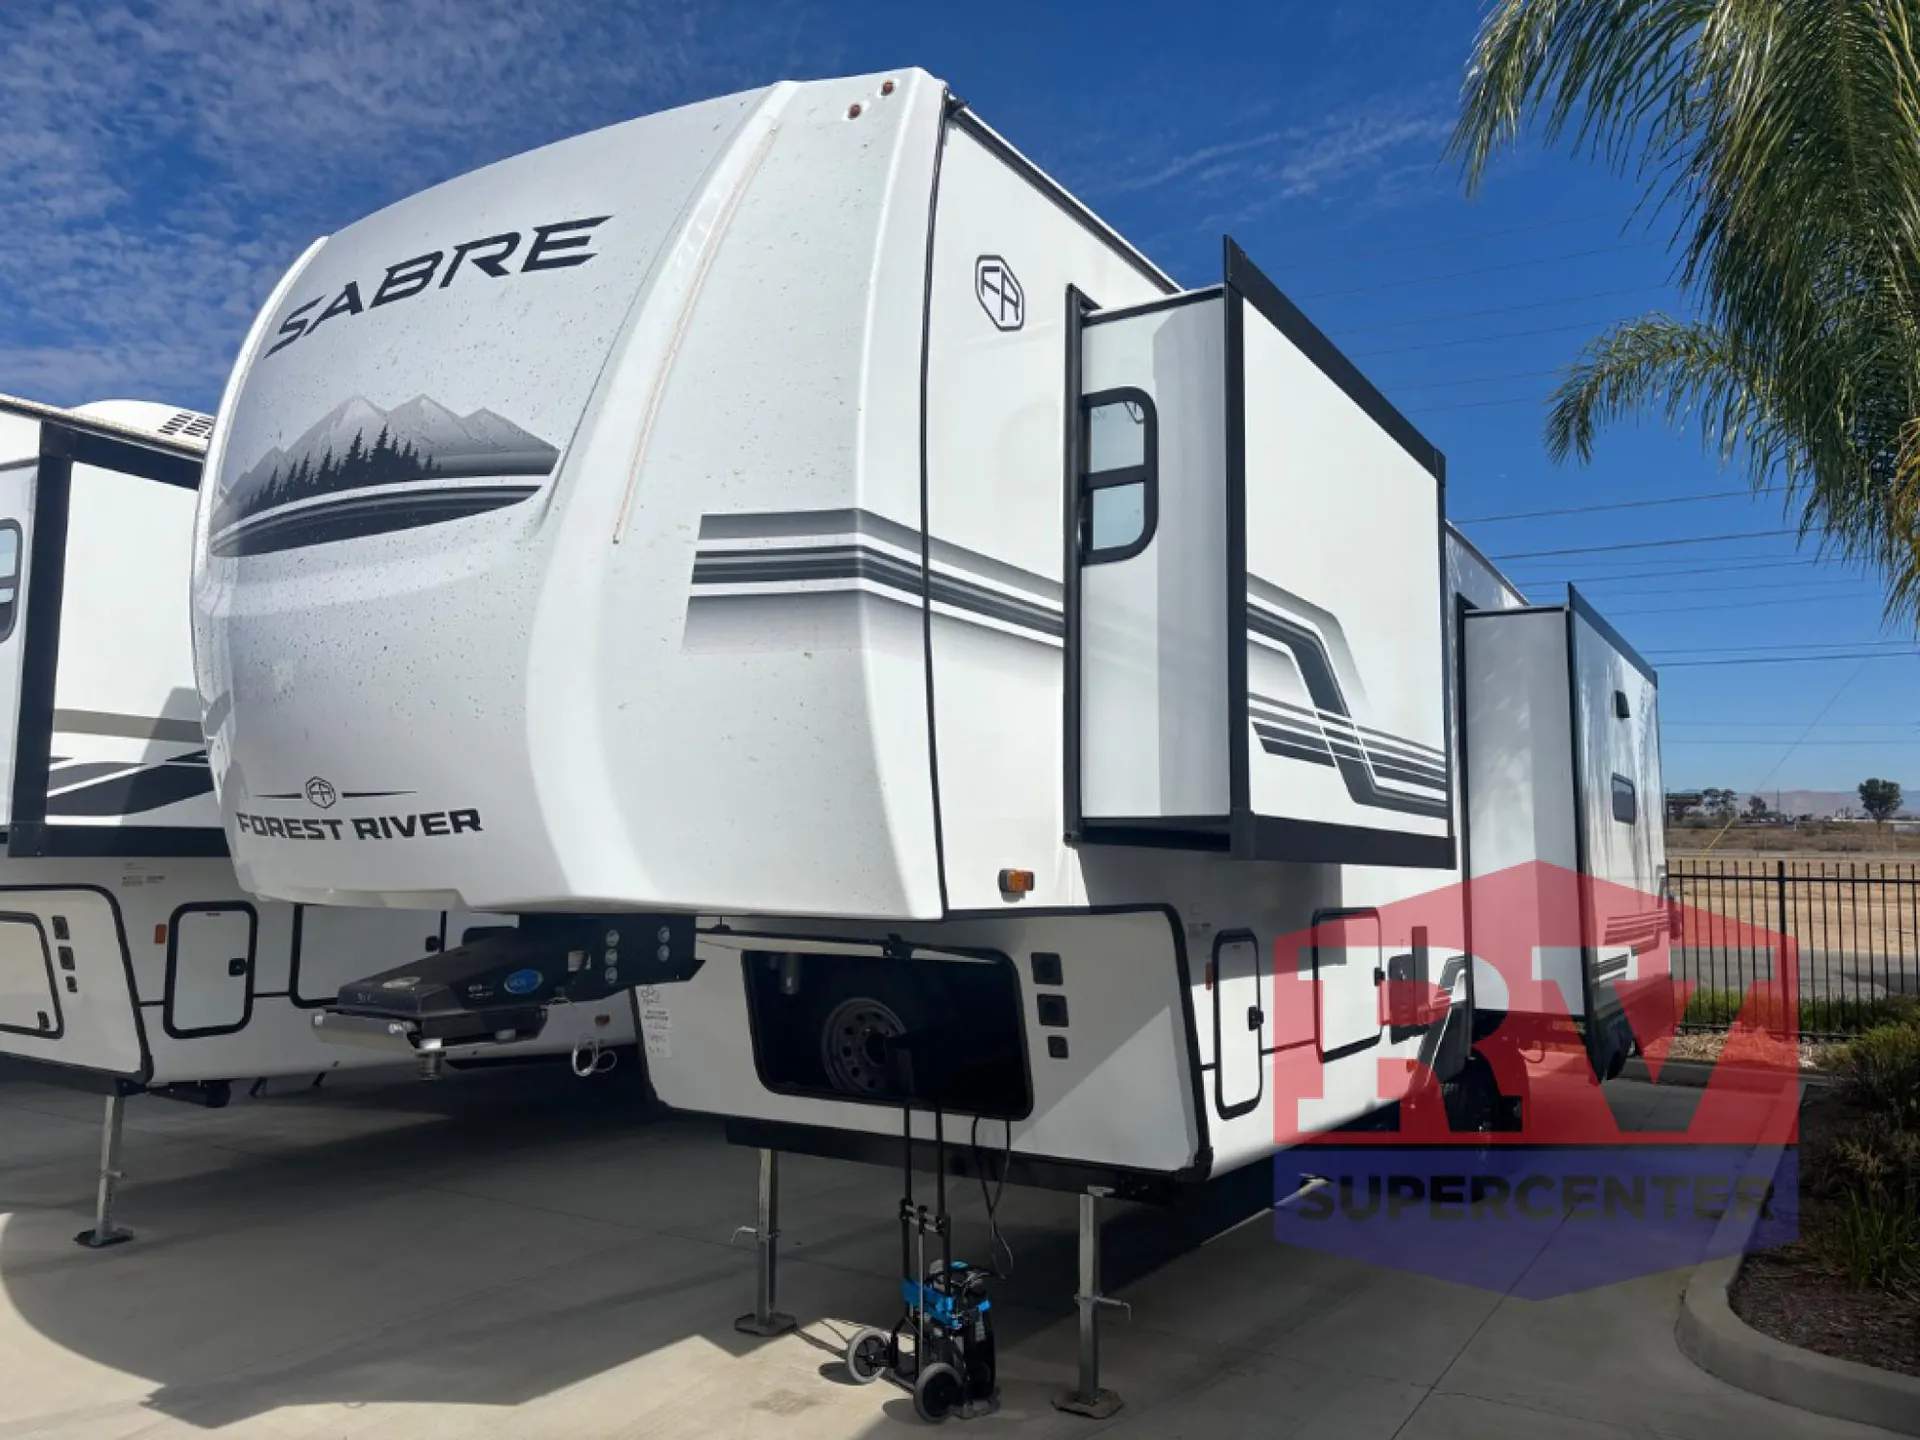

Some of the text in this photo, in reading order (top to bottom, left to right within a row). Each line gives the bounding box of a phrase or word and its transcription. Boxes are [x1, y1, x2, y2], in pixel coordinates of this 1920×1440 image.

[264, 215, 614, 359] SABRE
[235, 808, 483, 841] FOREST RIVER
